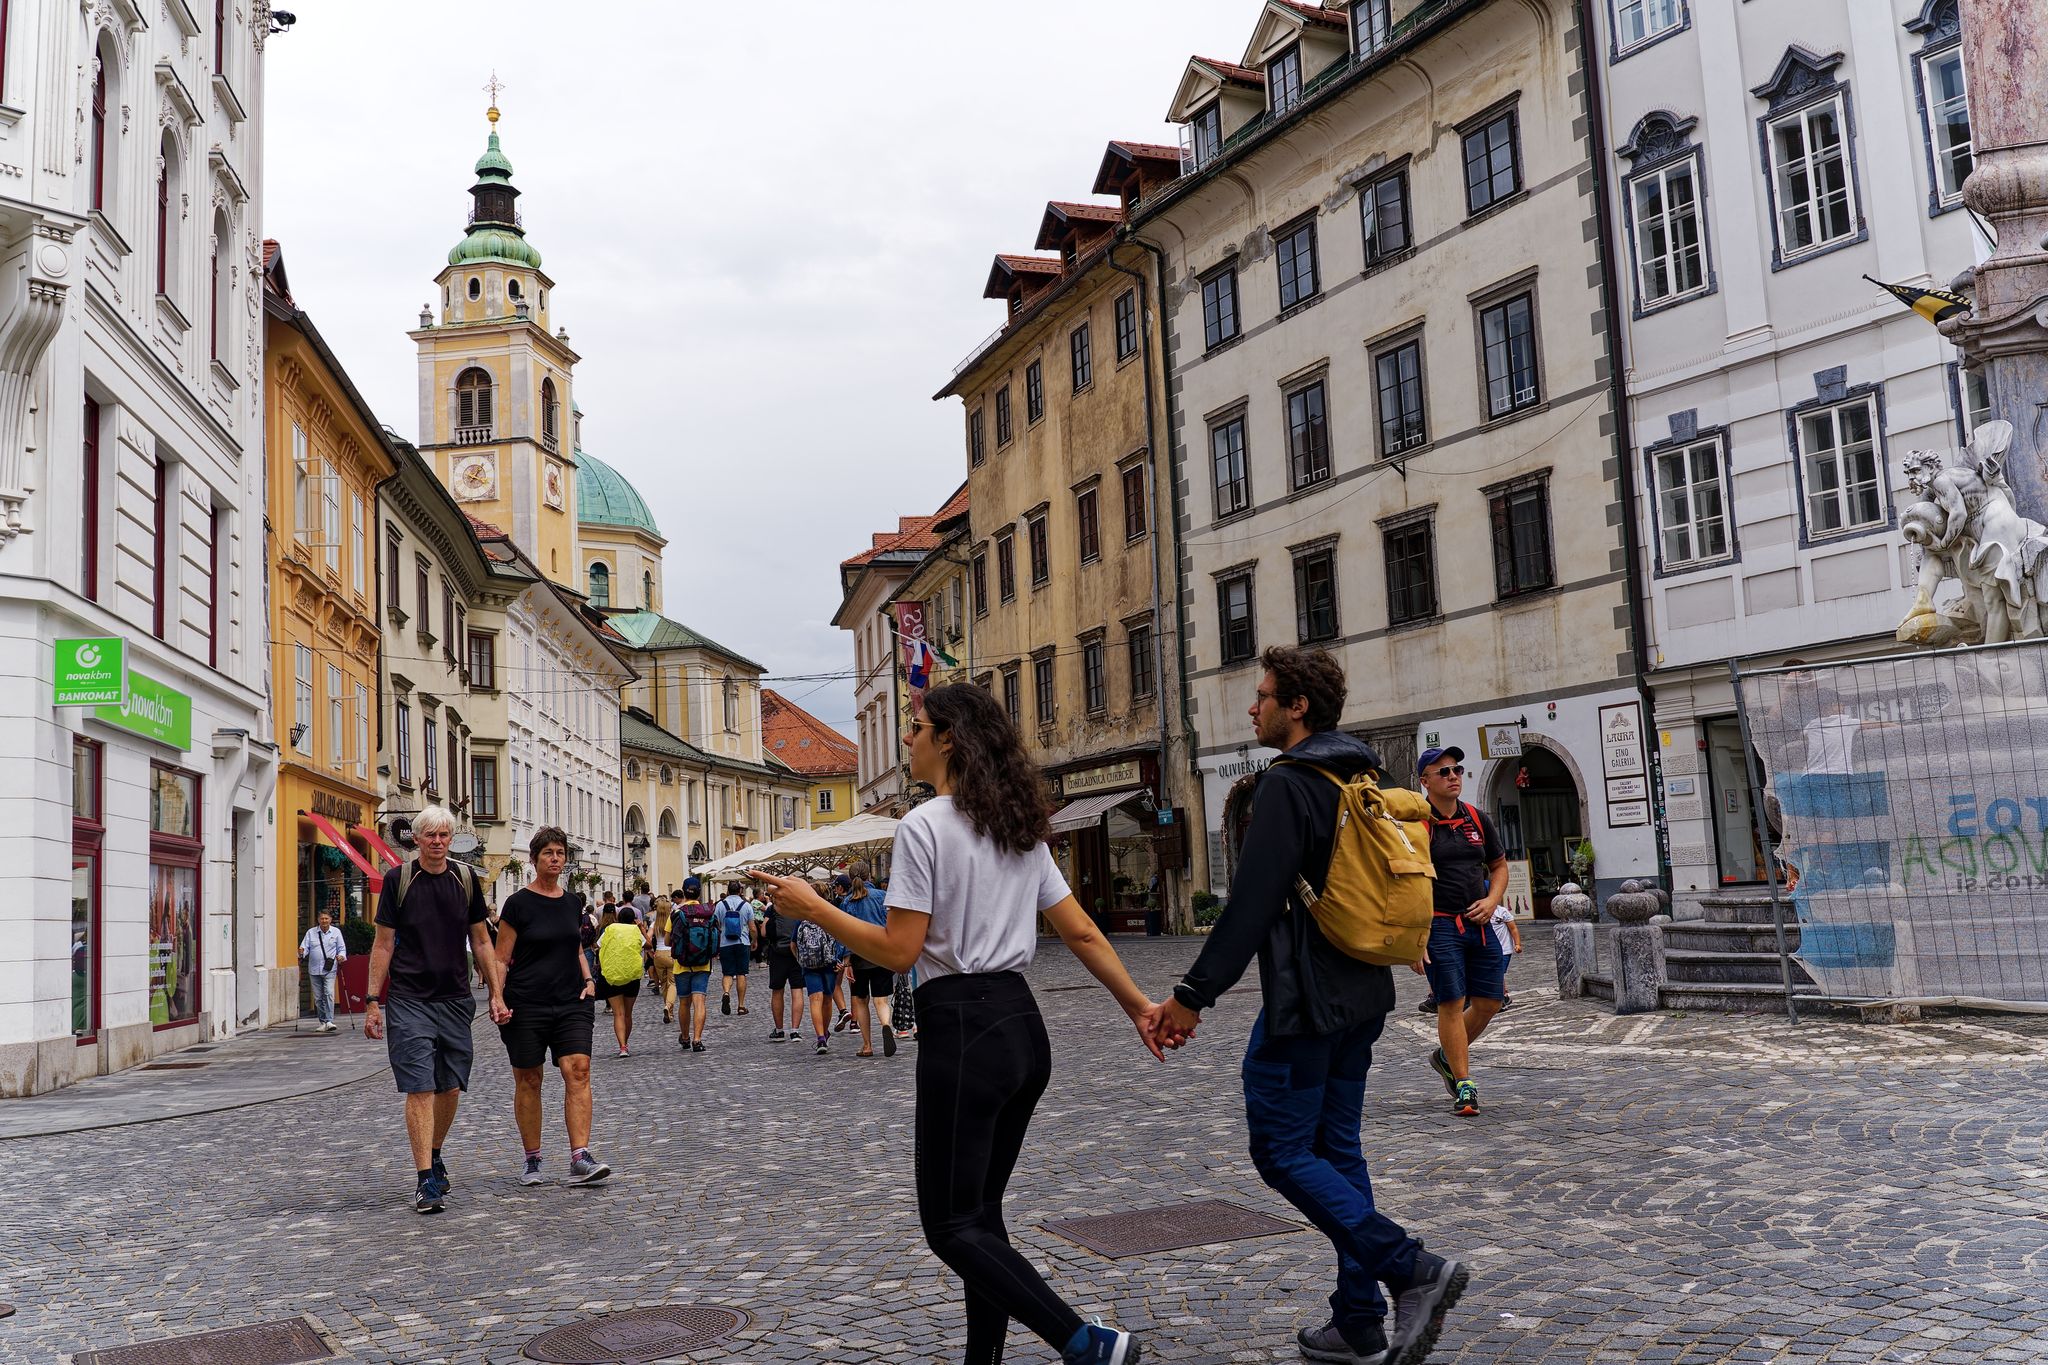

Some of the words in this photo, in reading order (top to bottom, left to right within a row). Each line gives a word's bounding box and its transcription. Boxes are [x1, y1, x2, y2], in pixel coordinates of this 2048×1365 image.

[66, 671, 111, 680] novakbm
[58, 691, 118, 701] BANKOMAT
[131, 693, 173, 728] novakbm
[1607, 731, 1635, 743] LAURA
[1490, 746, 1520, 756] LAURA
[1616, 748, 1629, 758] ETNO
[1219, 759, 1255, 778] OLIVIERS
[1257, 758, 1263, 772] &
[1263, 757, 1275, 770] C
[1611, 759, 1636, 768] GALERIJA
